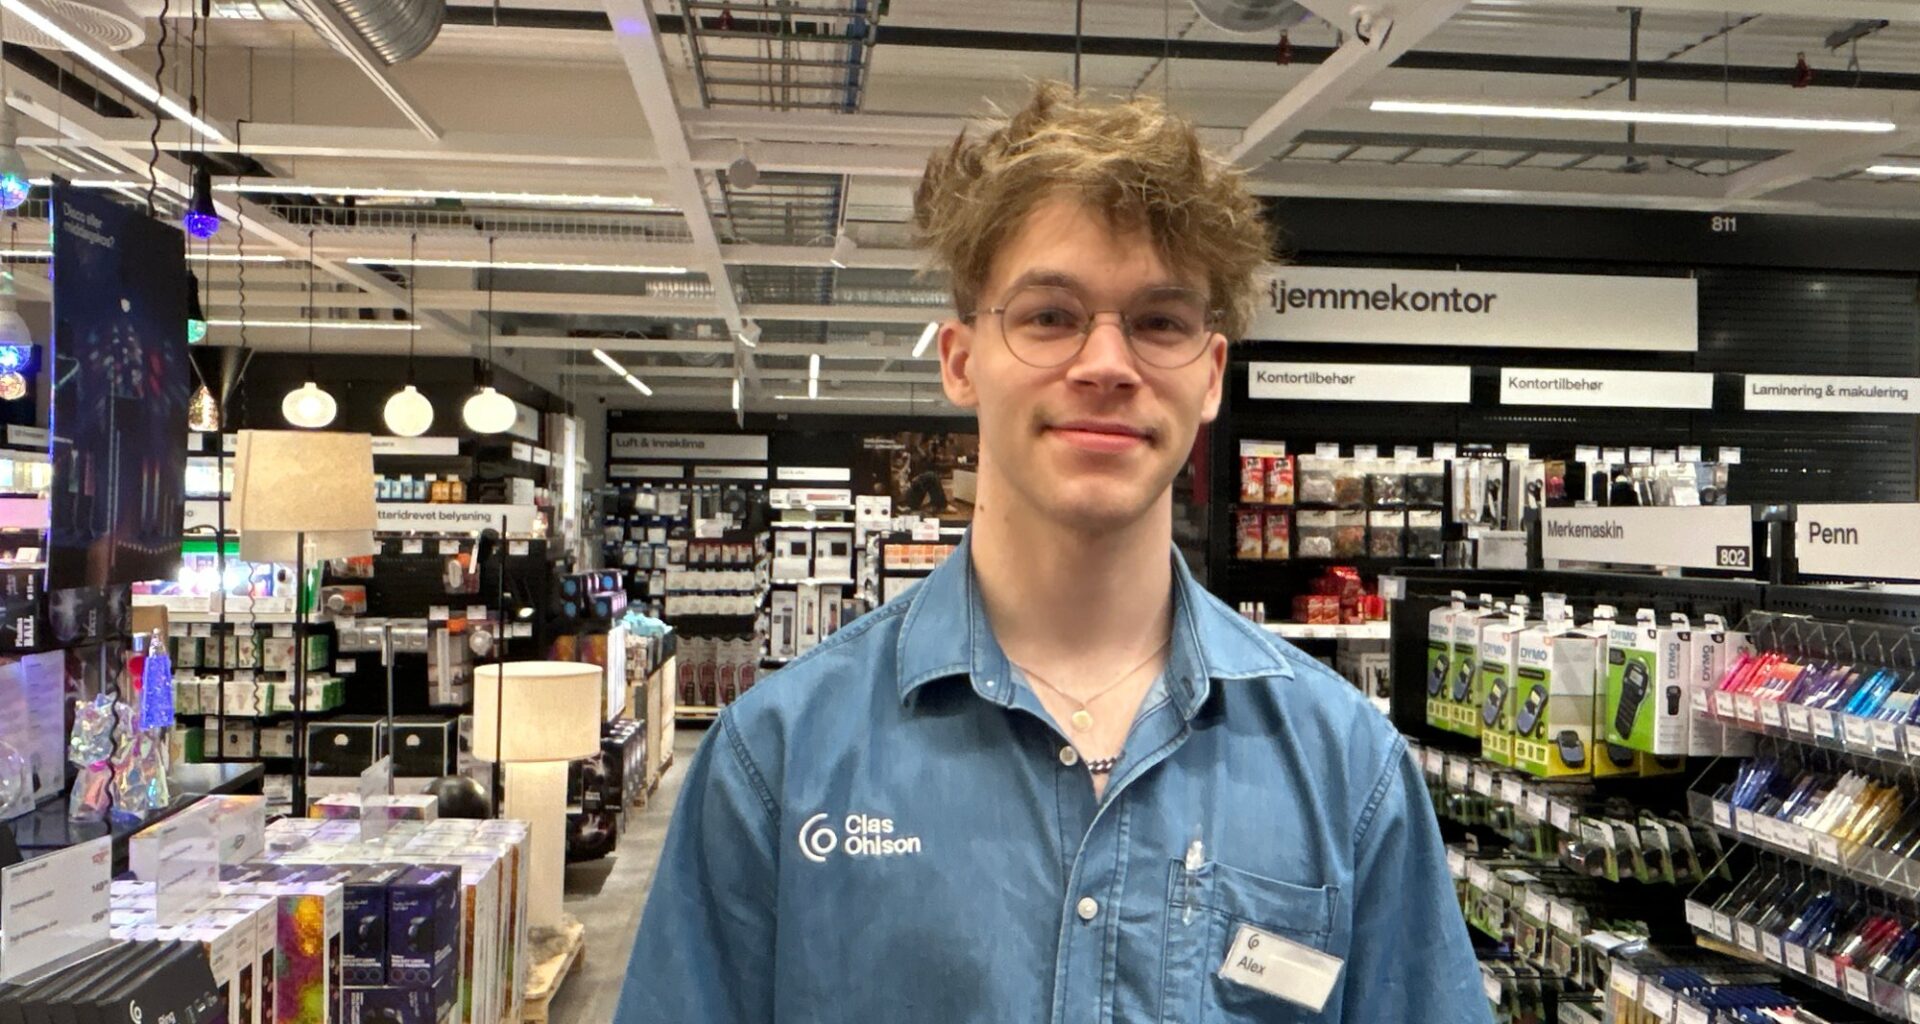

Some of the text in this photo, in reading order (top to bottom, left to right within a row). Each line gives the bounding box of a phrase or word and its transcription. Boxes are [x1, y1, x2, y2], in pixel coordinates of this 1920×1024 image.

[1712, 216, 1737, 232] 811
[1256, 371, 1355, 385] Kontortilbehør
[1508, 377, 1604, 391] Kontortilbehør
[1752, 383, 1909, 400] Laminering & makulering
[640, 439, 650, 449] &
[377, 510, 492, 523] tteridrevet belysning
[1547, 521, 1624, 539] Merkemaskin
[1809, 521, 1858, 545] Penn
[1720, 549, 1746, 565] 802
[1610, 629, 1637, 642] DYMO
[1484, 642, 1506, 656] DYMO
[1520, 647, 1548, 661] DYMO
[1668, 643, 1677, 679] DYMO
[1702, 645, 1711, 681] DYMO
[845, 814, 894, 834] Clas
[844, 835, 921, 855] Ohlson
[1237, 956, 1267, 975] Alex
